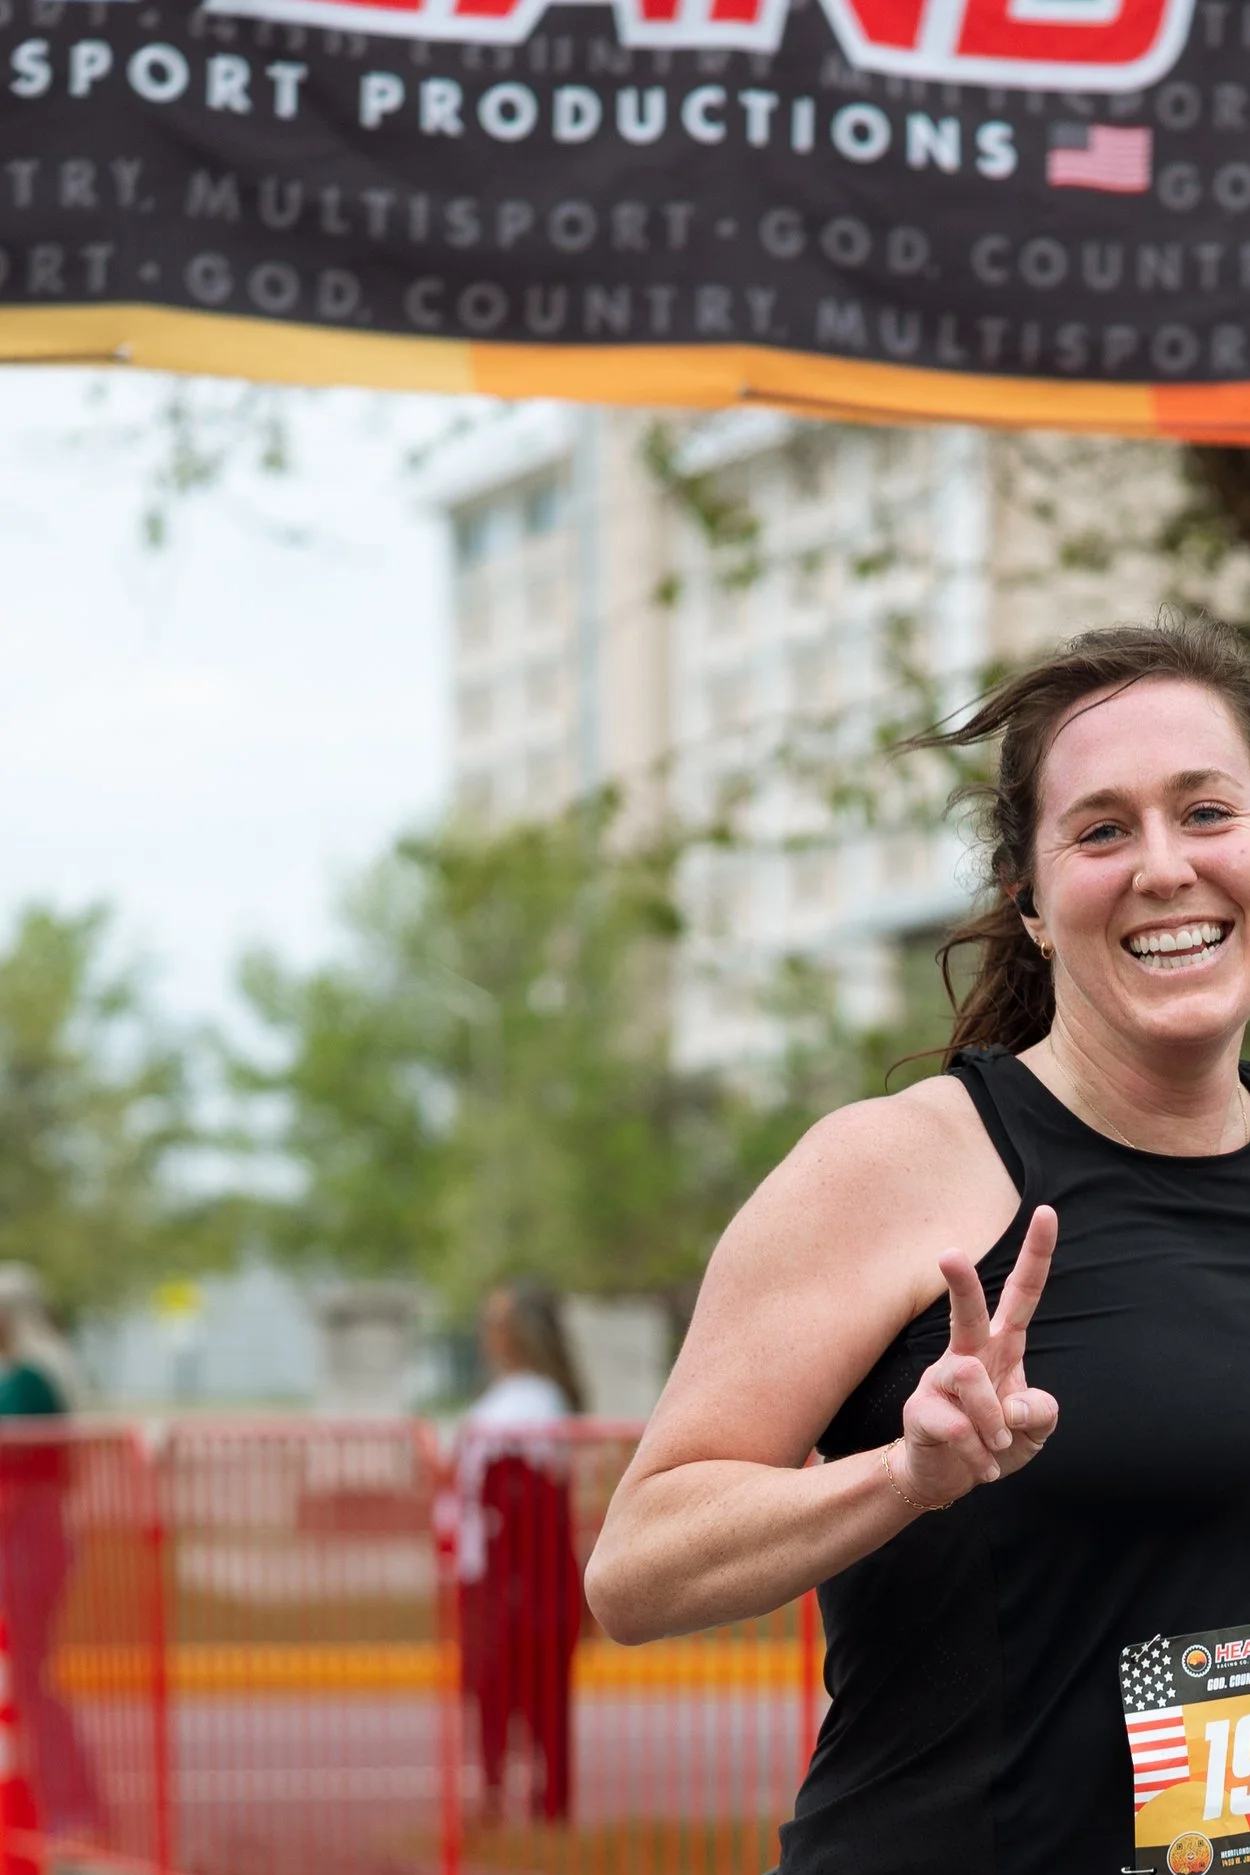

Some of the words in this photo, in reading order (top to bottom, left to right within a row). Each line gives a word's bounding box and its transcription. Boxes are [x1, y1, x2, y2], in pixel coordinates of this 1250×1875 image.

[9, 38, 308, 119] SPORT
[358, 71, 1018, 179] PRODUCTIONS
[184, 168, 696, 254] MULTISPORT
[1207, 1676, 1228, 1691] GOD.
